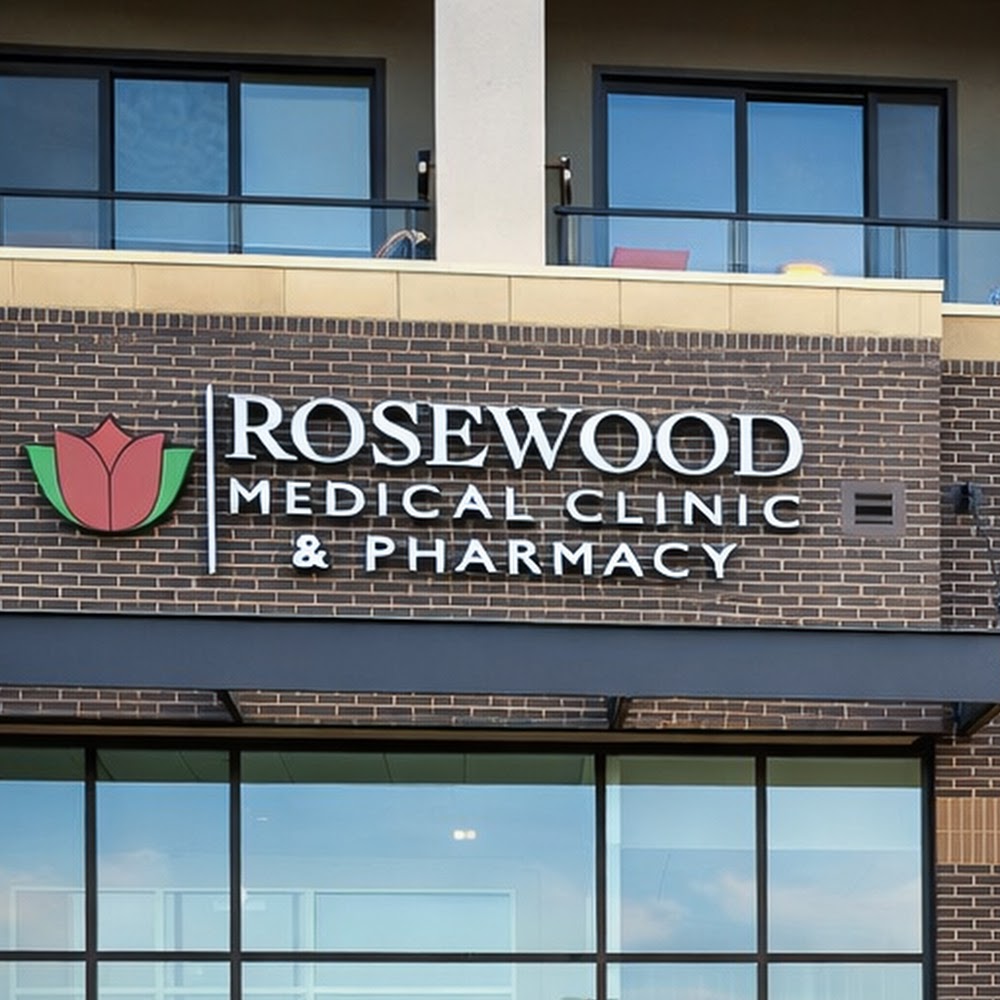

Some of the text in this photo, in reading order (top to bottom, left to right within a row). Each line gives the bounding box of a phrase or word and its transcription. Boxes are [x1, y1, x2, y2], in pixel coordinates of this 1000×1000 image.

[225, 393, 804, 477] ROSEWOOD
[229, 477, 801, 529] MEDICAL CLINIC
[292, 533, 738, 579] & PHARMACY
